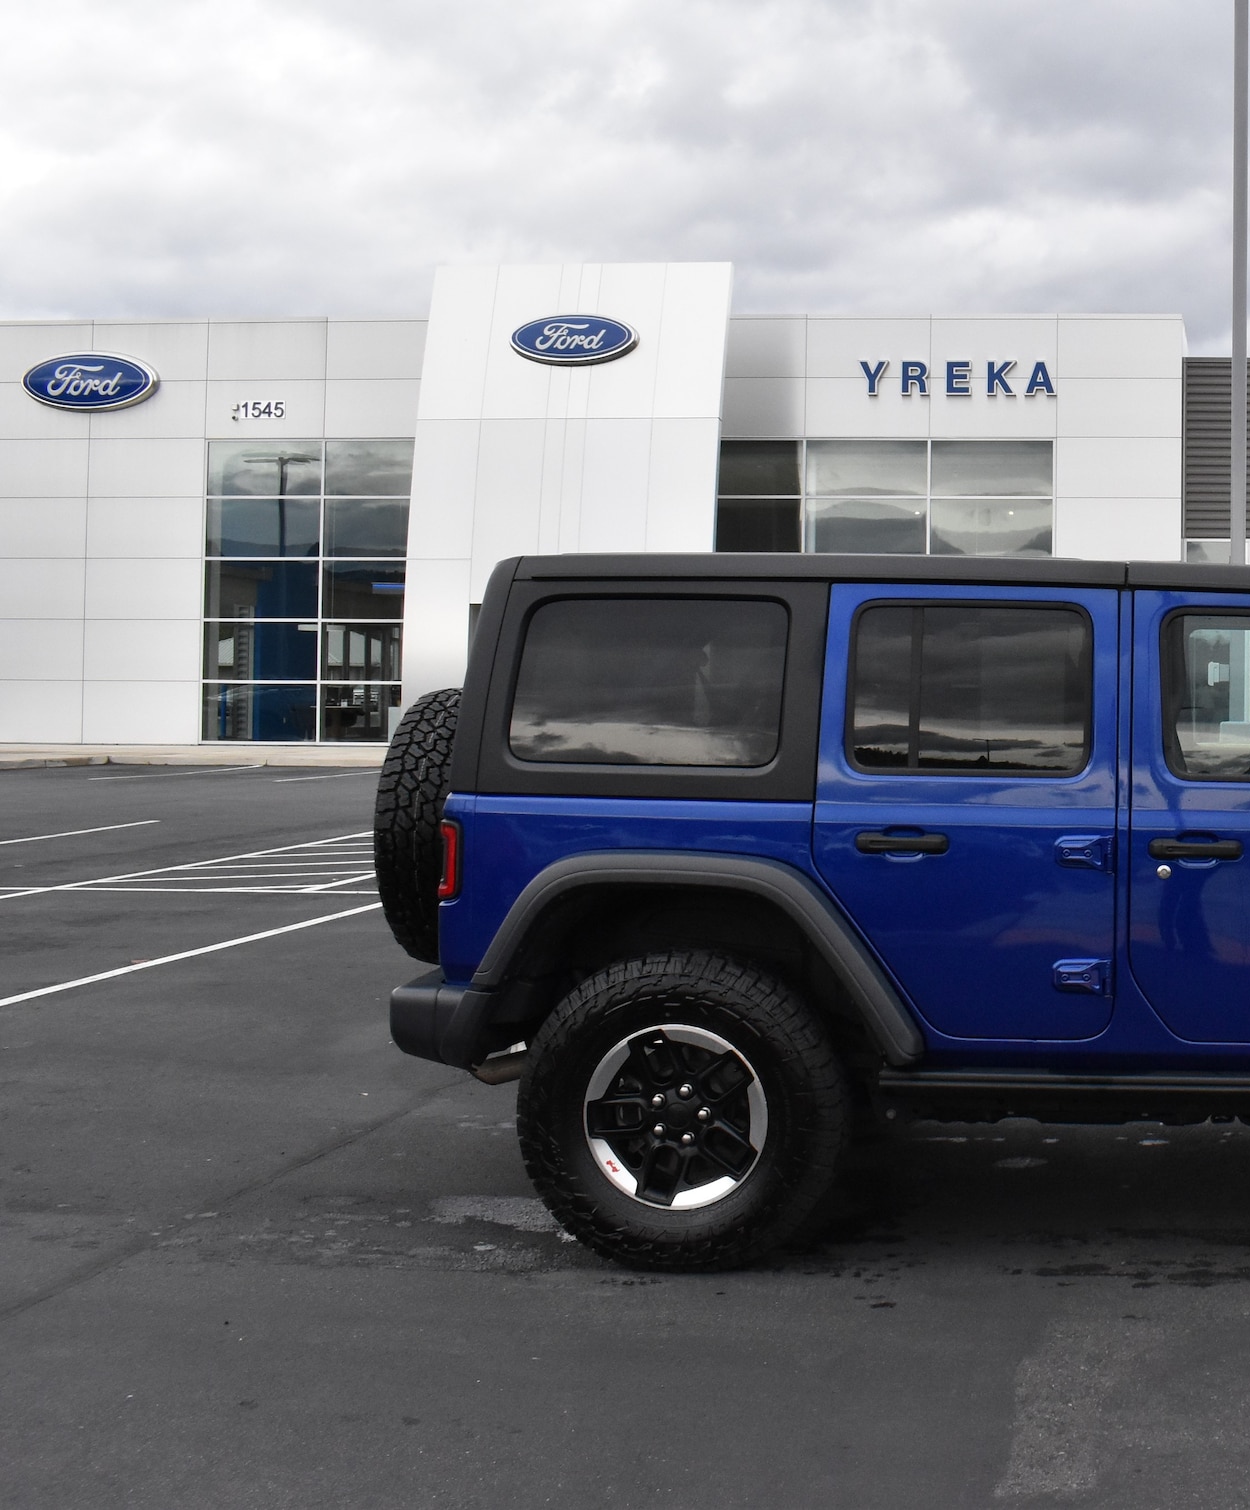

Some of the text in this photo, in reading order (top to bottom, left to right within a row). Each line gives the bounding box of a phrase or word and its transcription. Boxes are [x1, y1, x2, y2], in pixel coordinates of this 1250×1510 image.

[535, 322, 607, 350] Ford
[46, 363, 123, 396] Ford
[858, 360, 1058, 396] YREKA
[241, 401, 285, 418] 1545
